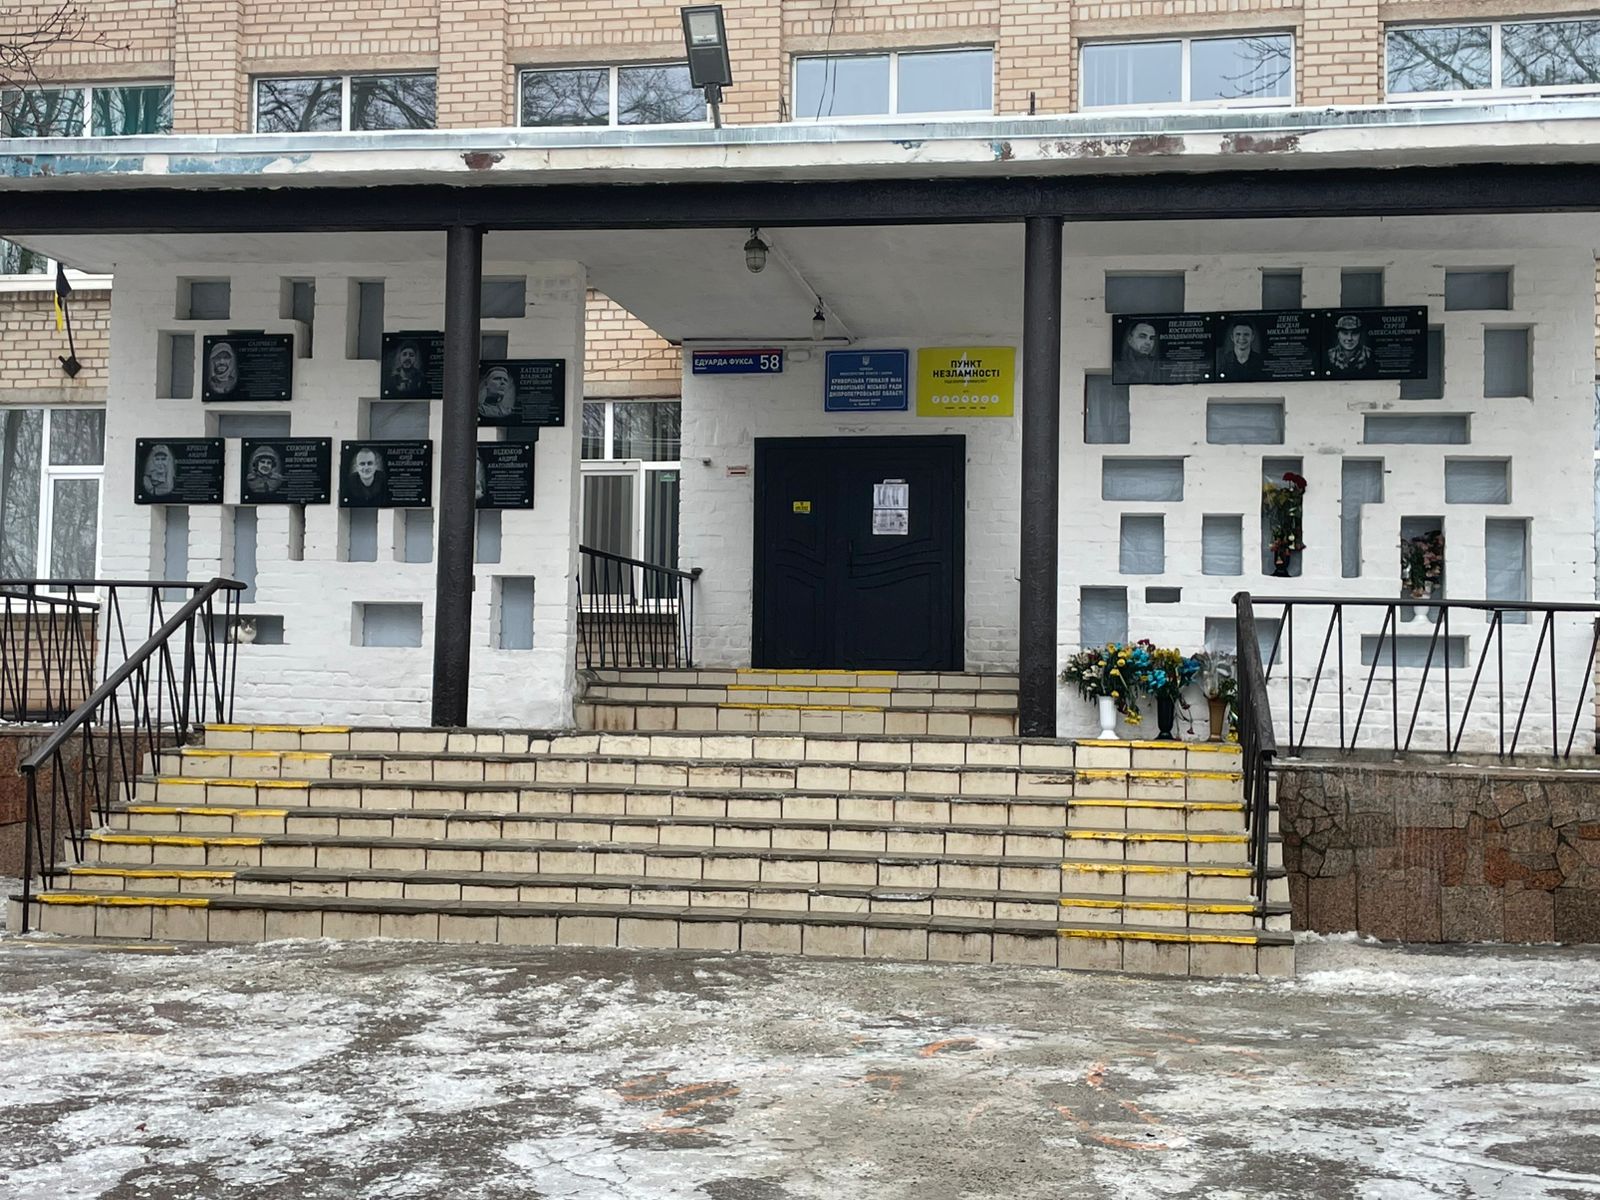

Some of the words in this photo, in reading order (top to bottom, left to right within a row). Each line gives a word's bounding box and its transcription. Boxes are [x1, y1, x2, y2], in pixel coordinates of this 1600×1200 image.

[694, 358, 728, 366] ЕДУАРДА
[760, 354, 780, 370] 58
[951, 360, 982, 368] ПУНКТ
[932, 369, 1000, 378] НЕЗЛАМНОСТІ
